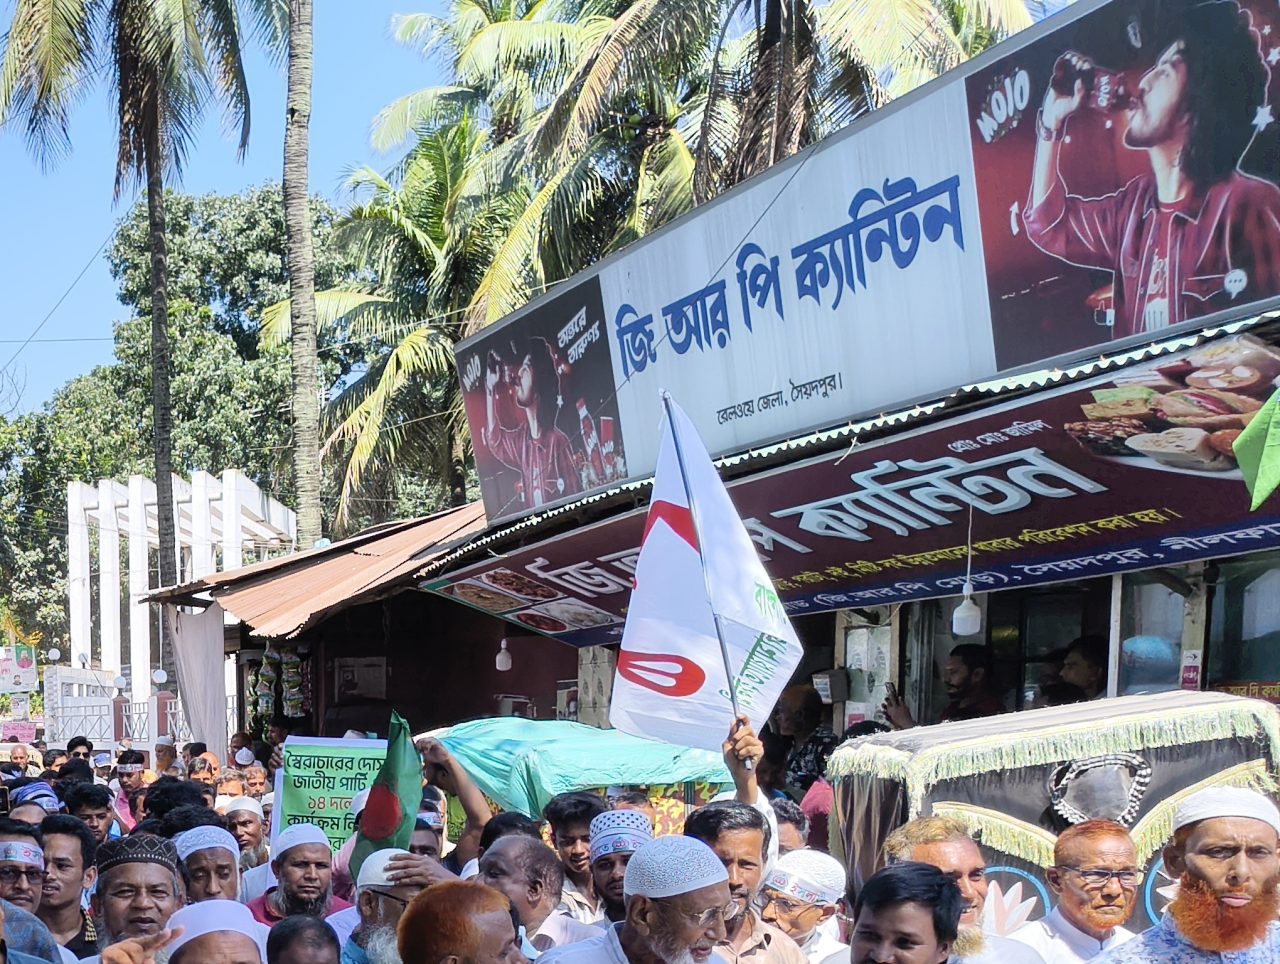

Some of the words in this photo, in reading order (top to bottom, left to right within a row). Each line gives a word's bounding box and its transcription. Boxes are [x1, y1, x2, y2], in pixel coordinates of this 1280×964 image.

[977, 69, 1030, 143] MOJO
[616, 303, 656, 382] জি
[662, 279, 731, 354] আর
[736, 242, 785, 333] পি
[791, 174, 965, 311] ক্যান্টিন
[717, 399, 755, 424] রেলওয়ে
[757, 390, 789, 413] জেলা,
[789, 372, 843, 402] সৈয়দপুর।
[770, 447, 1108, 542] ক্যান্টিন
[1092, 512, 1143, 532] করা
[285, 750, 355, 772] স্বৈরাচারের
[358, 757, 386, 772] দোস
[293, 770, 336, 791] জাতীয়
[339, 772, 368, 791] পার্টি
[308, 796, 326, 810] ১৪
[329, 796, 353, 811] দলে
